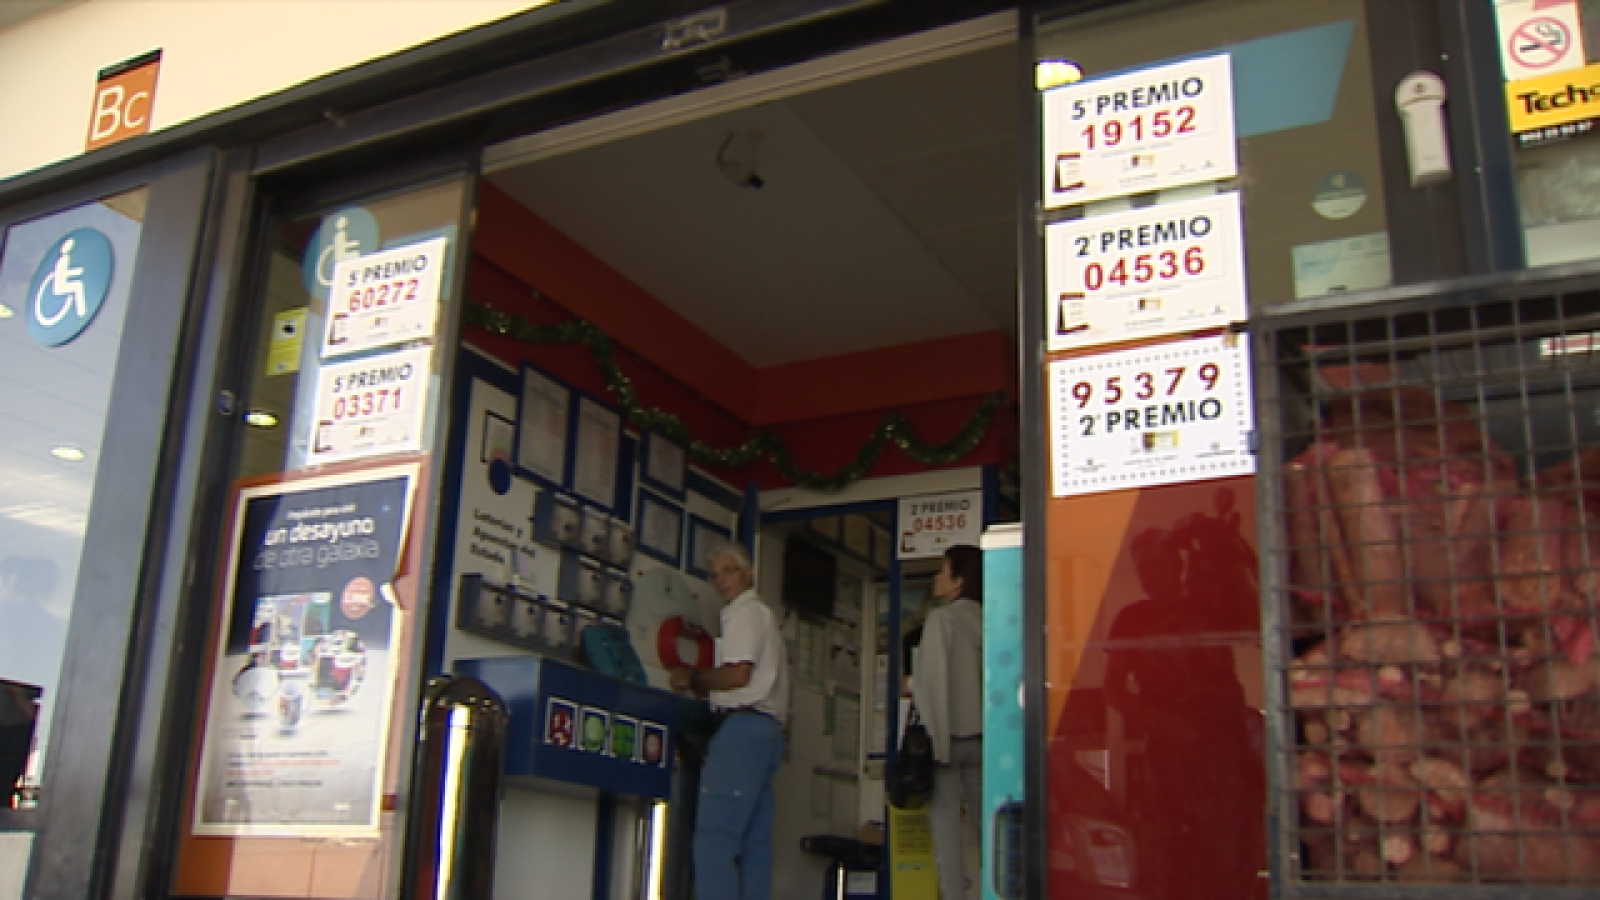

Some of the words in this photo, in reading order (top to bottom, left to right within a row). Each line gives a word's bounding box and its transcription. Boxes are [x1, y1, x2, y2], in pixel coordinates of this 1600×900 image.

[90, 85, 148, 141] Bc
[1096, 77, 1204, 115] PREMIO
[1080, 105, 1196, 149] 19152
[1101, 215, 1212, 252] PREMIO
[362, 254, 428, 282] PREMIO
[1084, 246, 1205, 290] 04536
[348, 278, 419, 312] 60272
[348, 362, 413, 389] PREMIO
[1071, 362, 1220, 408] 95379
[333, 387, 402, 420] 03371
[1106, 397, 1222, 432] PREMIO
[913, 513, 966, 532] 04536
[922, 499, 970, 514] PREMIO
[264, 528, 287, 545] un
[290, 517, 375, 543] desayuno
[317, 540, 378, 568] galaxia
